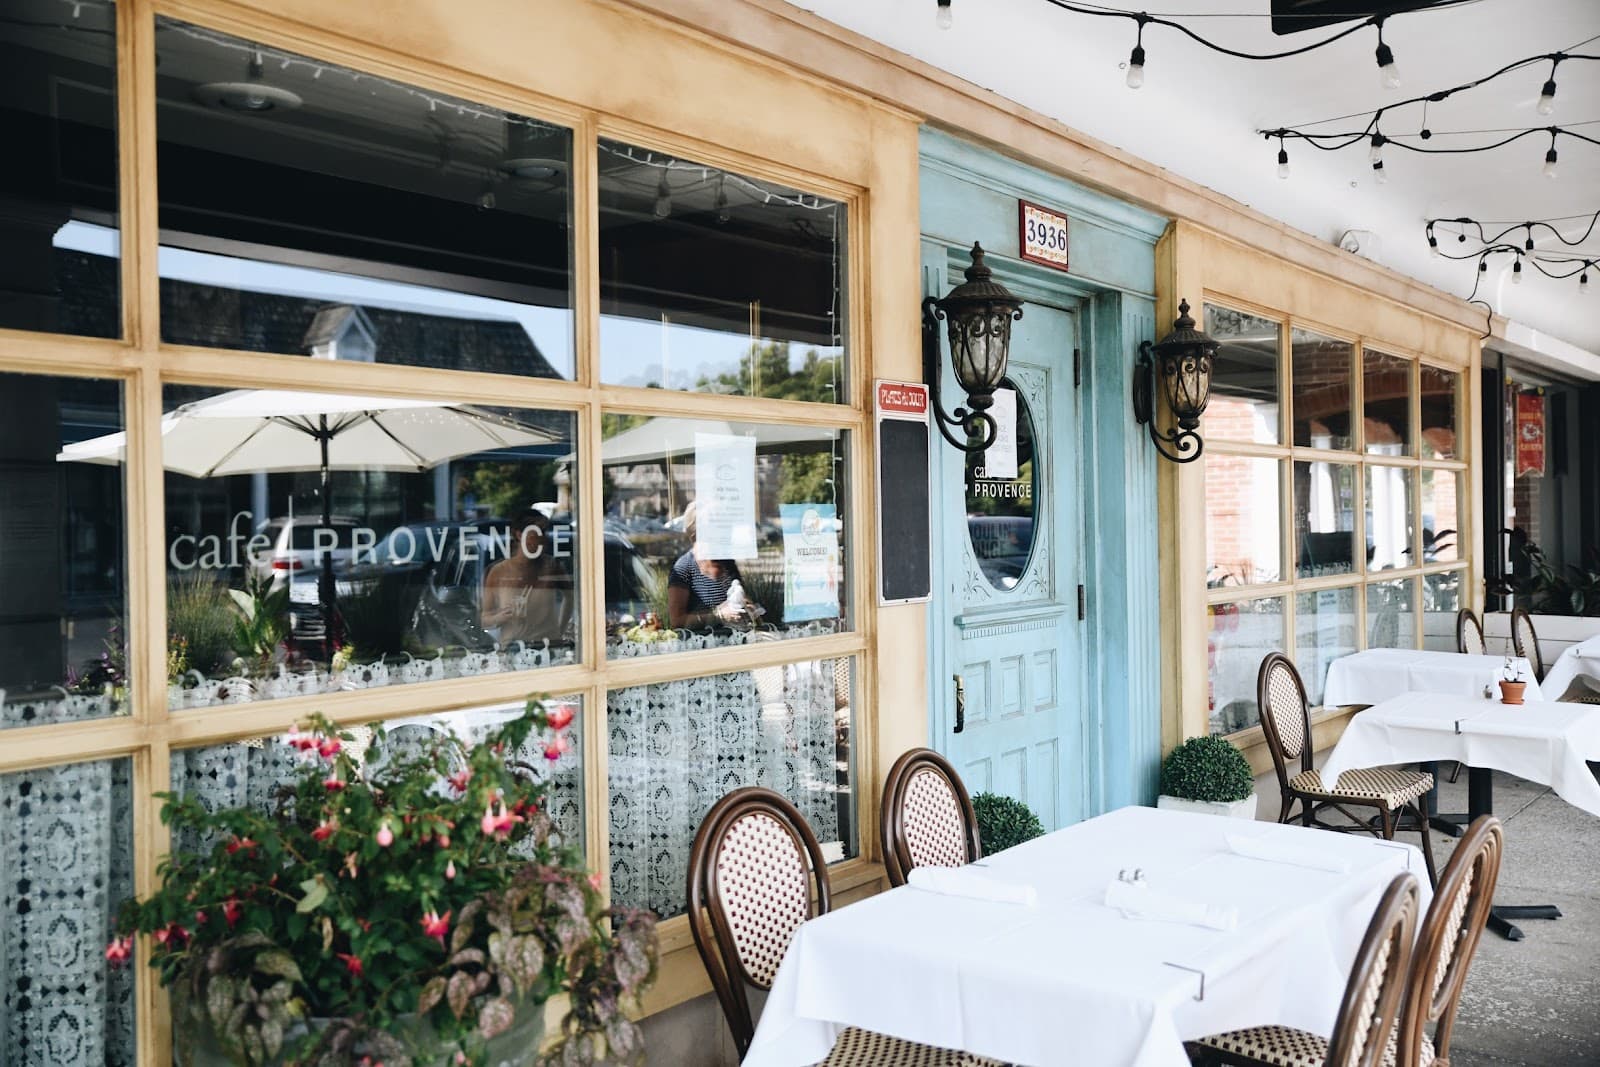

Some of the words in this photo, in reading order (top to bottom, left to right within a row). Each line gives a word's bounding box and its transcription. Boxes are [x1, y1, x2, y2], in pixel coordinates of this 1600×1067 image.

[1027, 219, 1066, 251] 3936
[974, 483, 1032, 498] PROVENCE
[169, 510, 272, 571] café
[313, 523, 572, 566] PROVENCE
